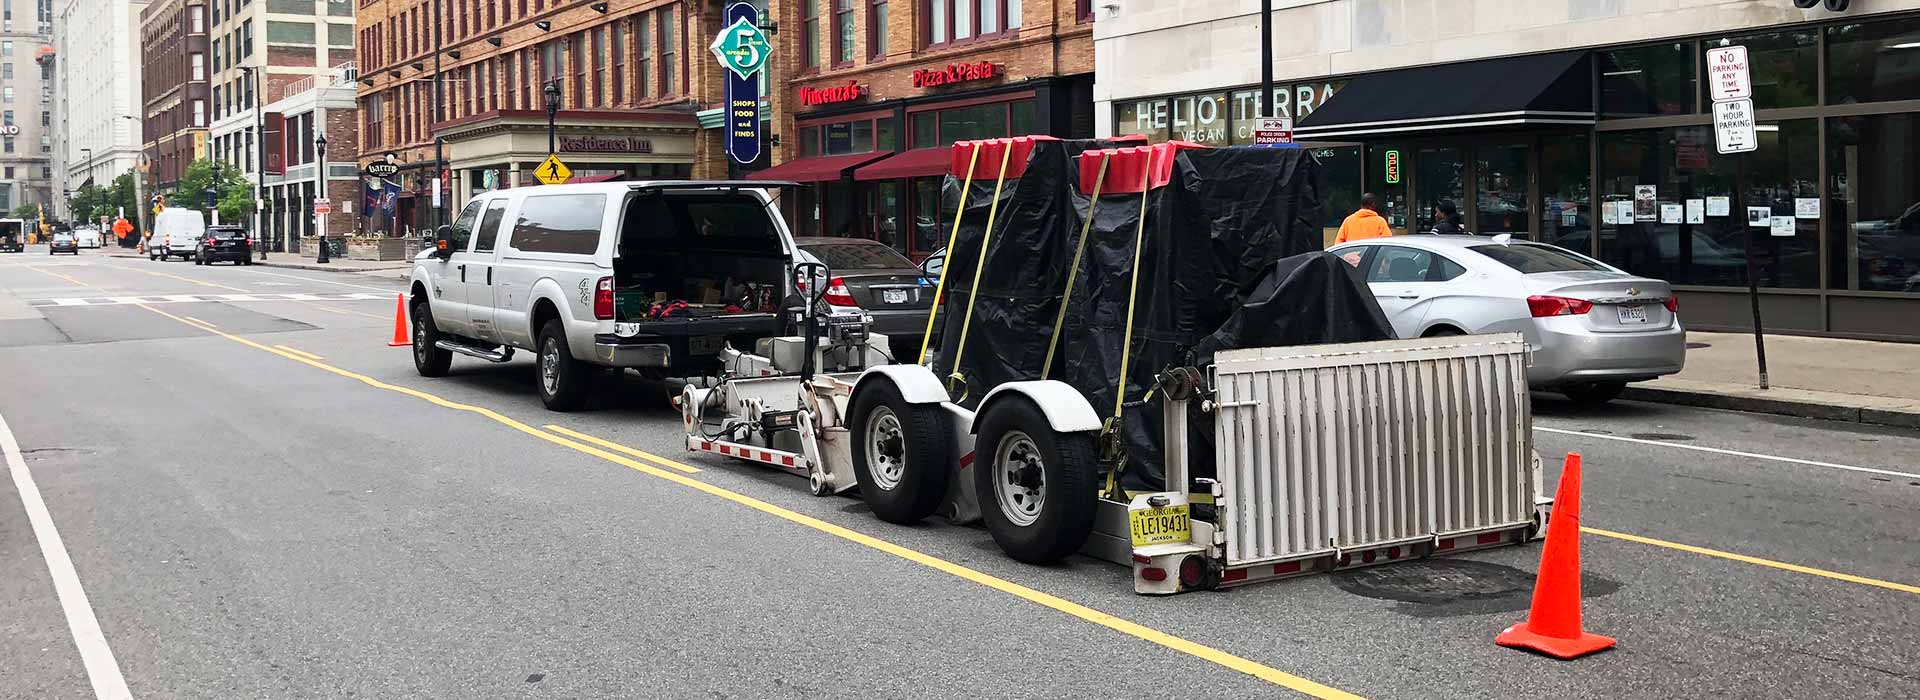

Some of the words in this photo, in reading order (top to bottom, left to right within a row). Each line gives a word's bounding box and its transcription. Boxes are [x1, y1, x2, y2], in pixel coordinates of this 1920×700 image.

[1720, 53, 1735, 63] NO
[913, 69, 943, 88] Pizza
[946, 65, 957, 83] &
[957, 61, 992, 80] Pasta
[1712, 63, 1744, 72] PARKING
[800, 80, 858, 106] Vincenza's
[1136, 96, 1217, 130] HELIO
[1723, 111, 1744, 120] HOUR
[1719, 120, 1751, 129] PARKING
[1181, 128, 1225, 143] VEGAN
[559, 136, 627, 152] Residence
[627, 136, 653, 153] Inn
[1388, 153, 1397, 181] OPEN
